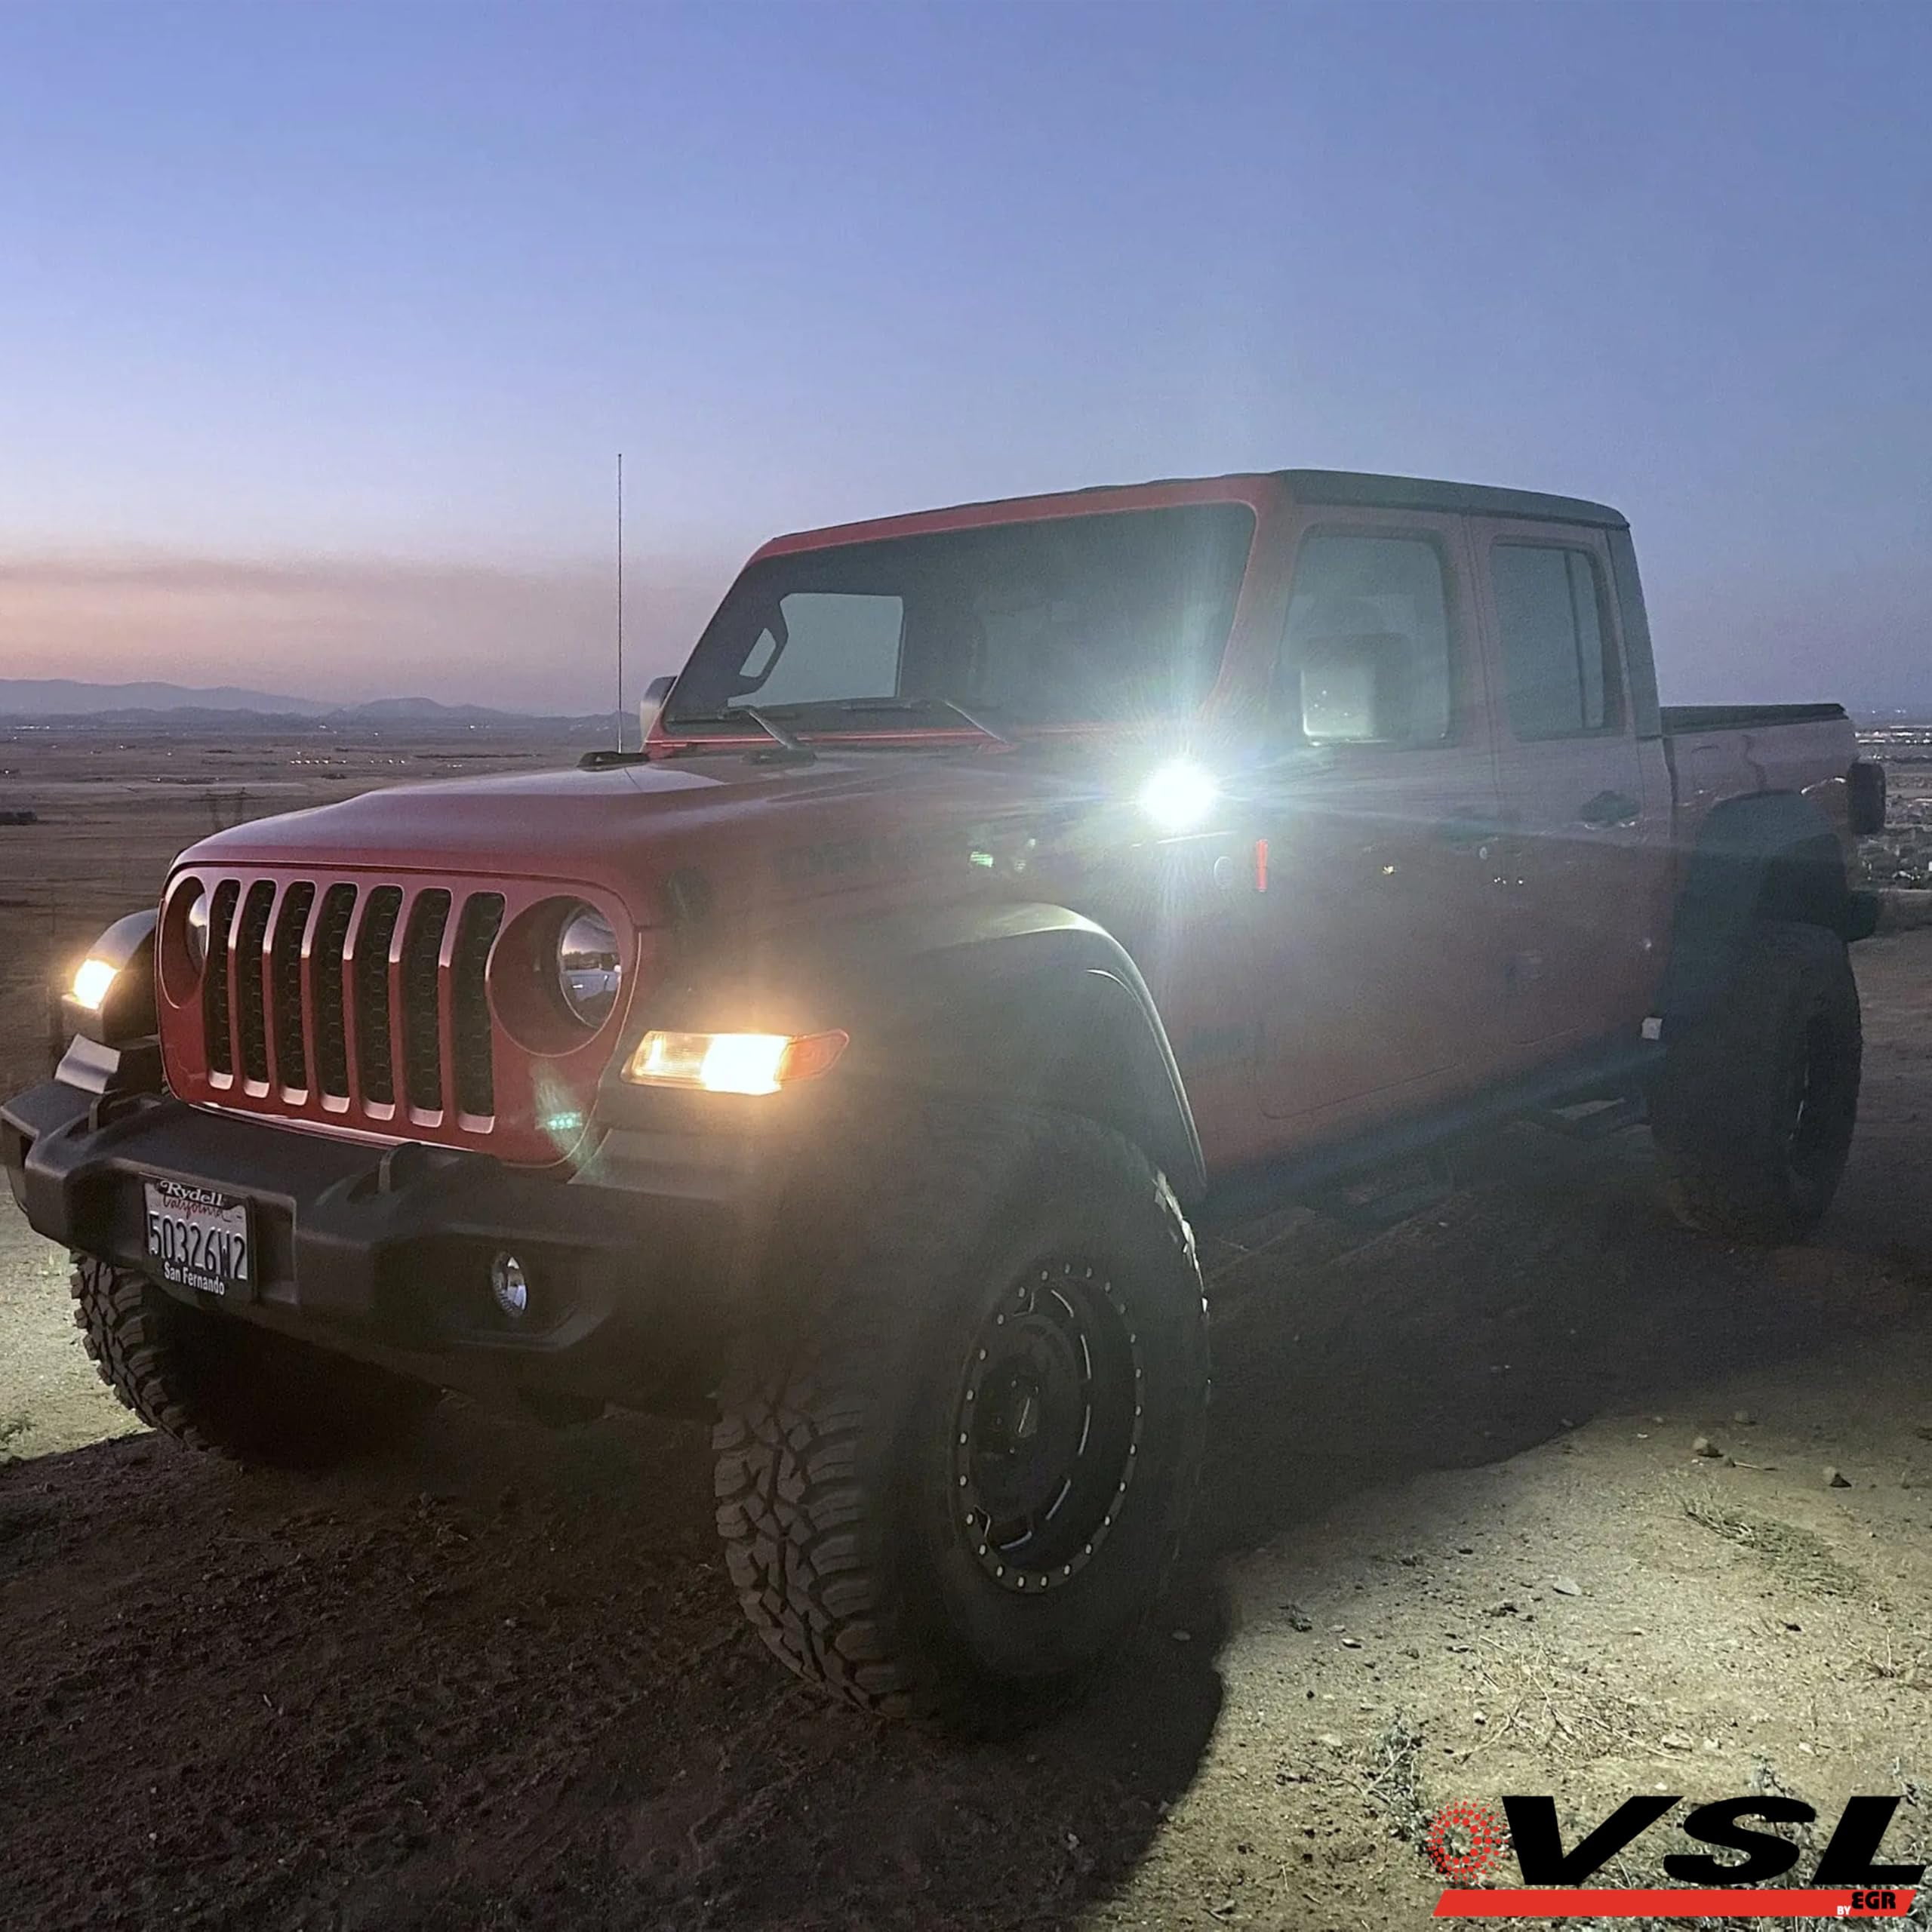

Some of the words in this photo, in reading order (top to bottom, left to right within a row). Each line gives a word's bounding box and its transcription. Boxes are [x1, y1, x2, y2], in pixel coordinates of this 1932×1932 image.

[160, 1180, 223, 1208] Rydell
[149, 1210, 248, 1281] 50326W2
[164, 1261, 181, 1282] San
[183, 1266, 225, 1296] Fernando
